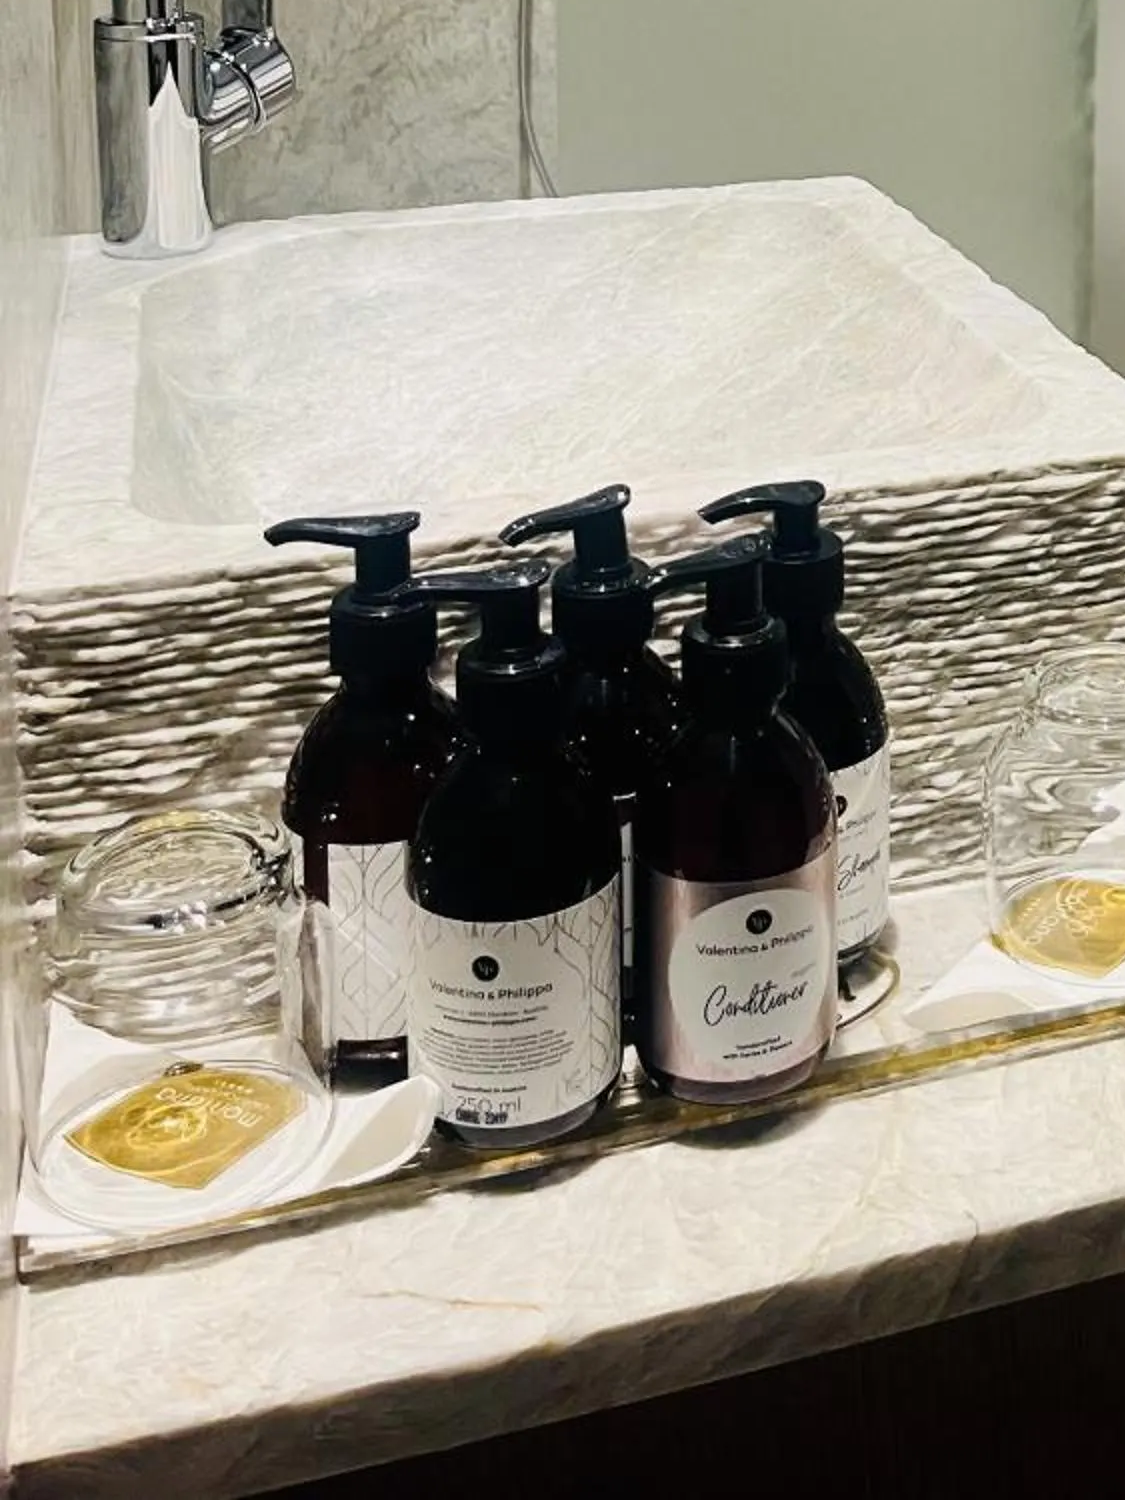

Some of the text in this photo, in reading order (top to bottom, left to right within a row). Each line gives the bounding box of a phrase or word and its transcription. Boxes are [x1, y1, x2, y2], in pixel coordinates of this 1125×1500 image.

[695, 943, 759, 957] Valentina
[429, 978, 485, 1001] Valentina
[497, 982, 553, 1000] Philippa
[703, 979, 809, 1027] Conditioner
[498, 1094, 521, 1113] ml
